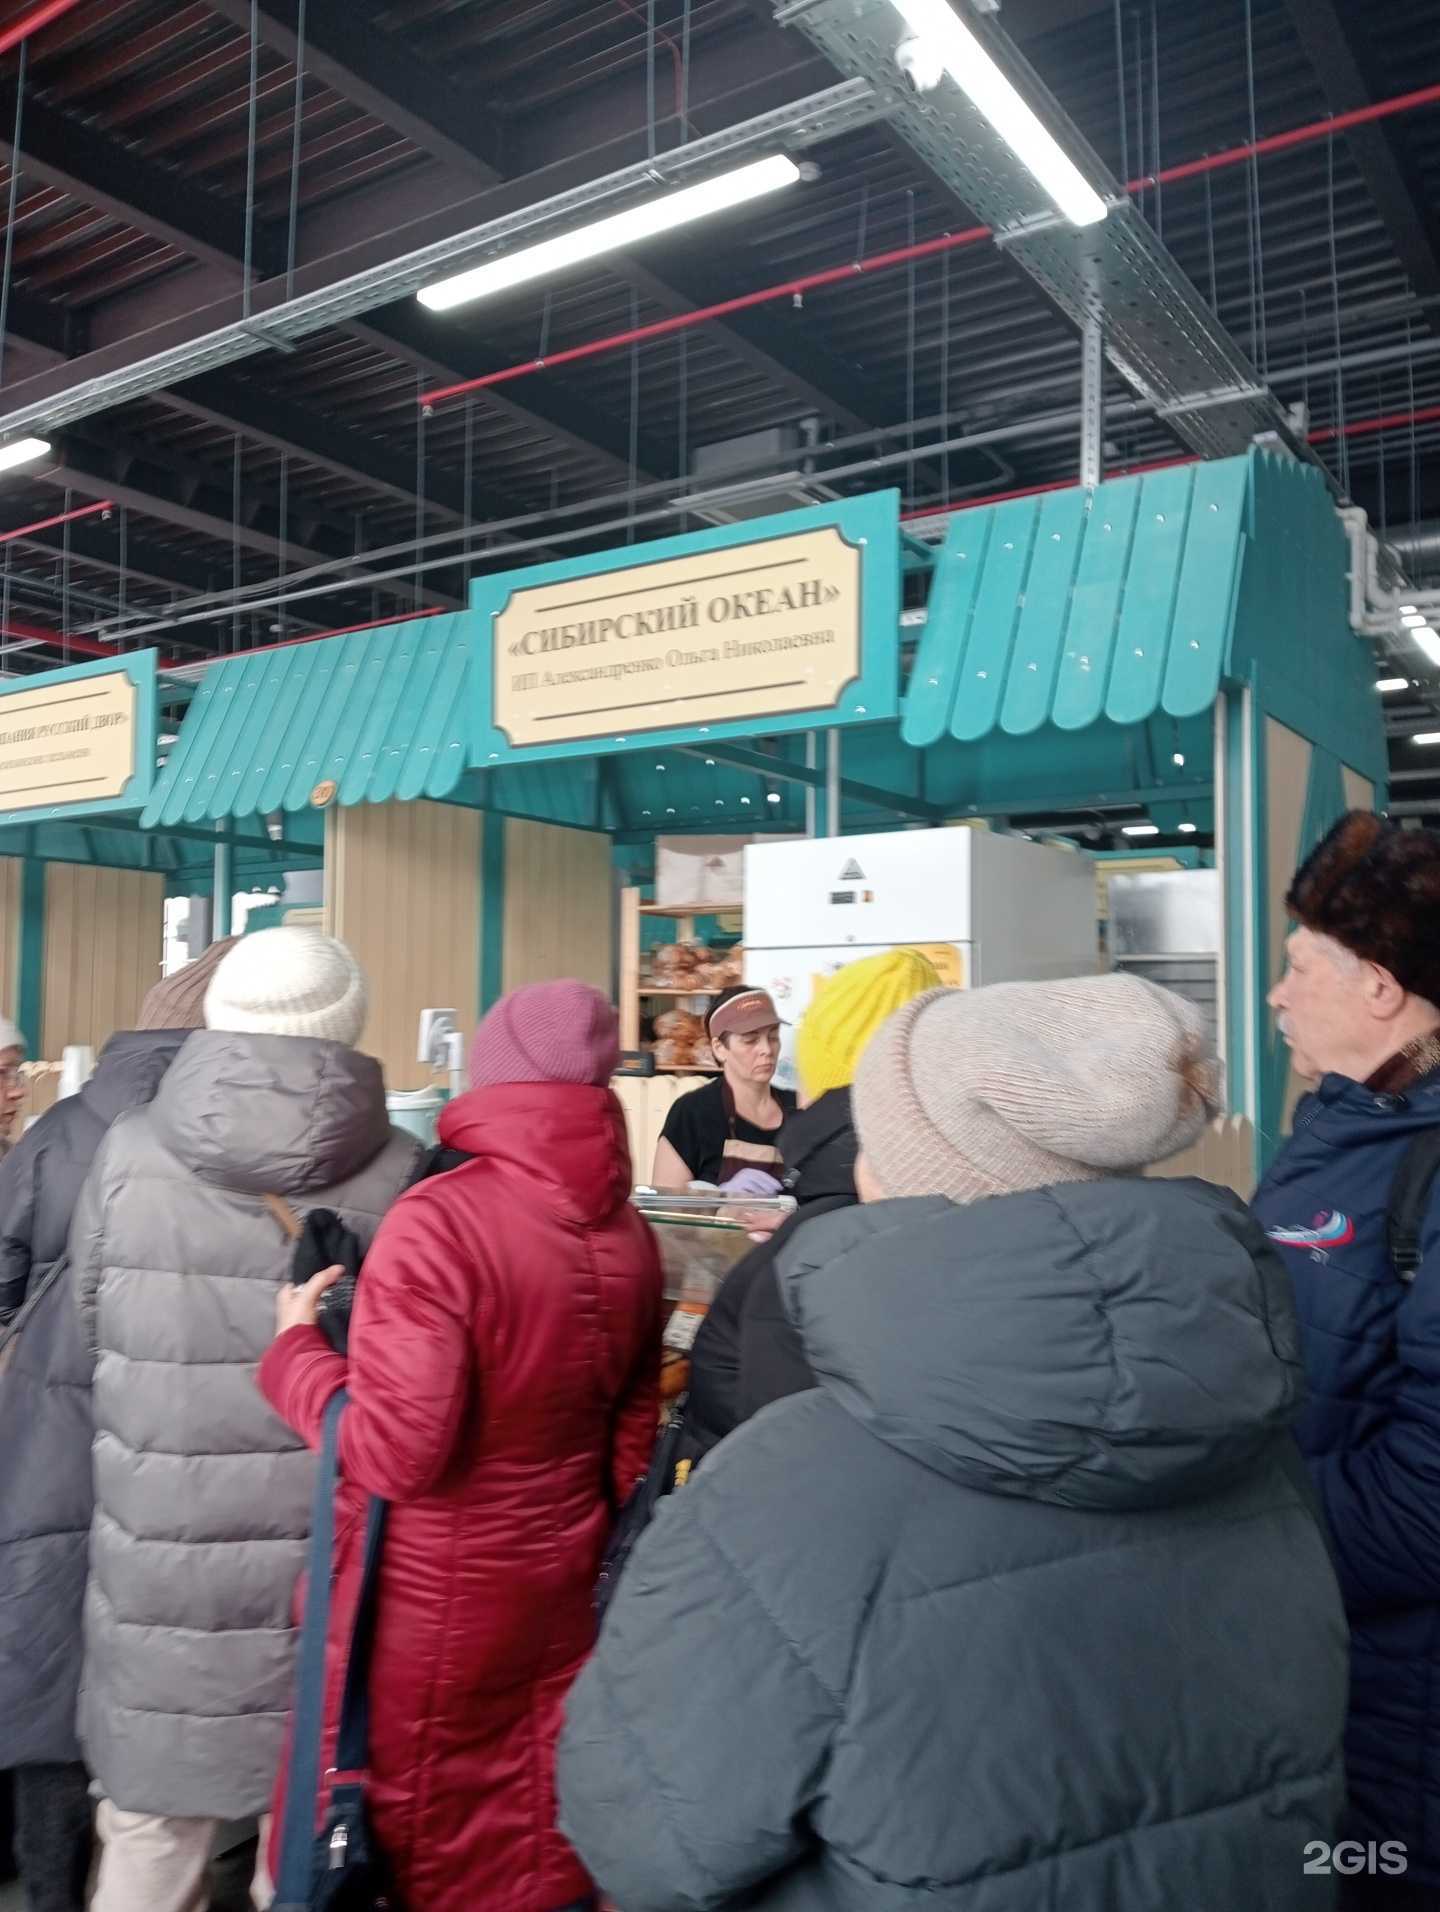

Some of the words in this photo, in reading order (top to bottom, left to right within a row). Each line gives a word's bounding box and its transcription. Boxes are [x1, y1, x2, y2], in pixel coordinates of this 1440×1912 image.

[508, 597, 698, 656] «СИБИРСКИЙ
[707, 579, 840, 623] ОКЕАН»
[665, 649, 719, 668] Ольга
[722, 630, 835, 658] Николаевна
